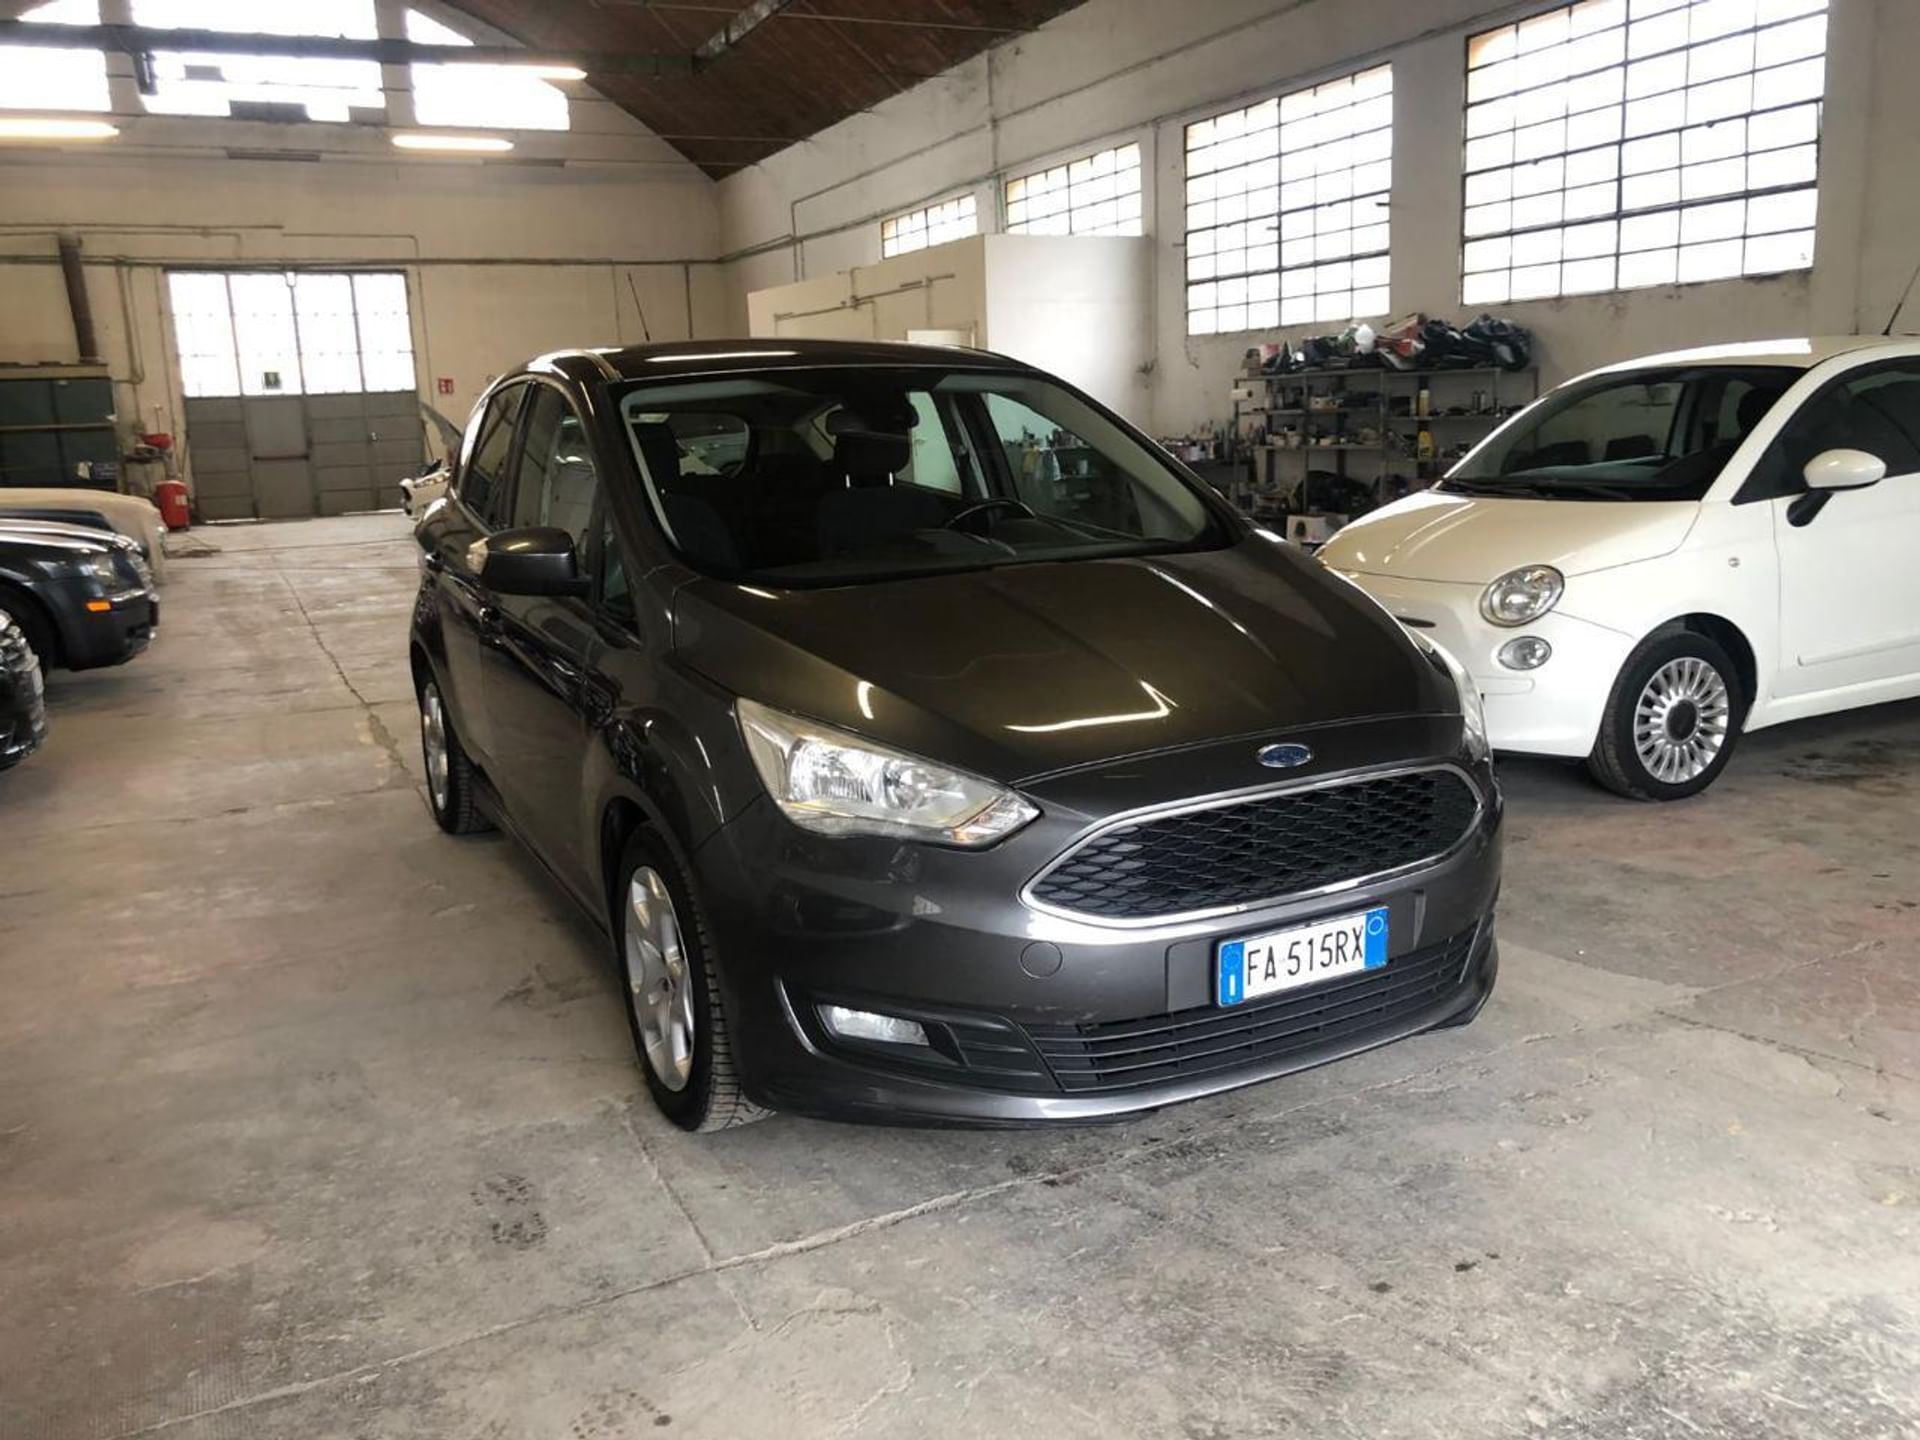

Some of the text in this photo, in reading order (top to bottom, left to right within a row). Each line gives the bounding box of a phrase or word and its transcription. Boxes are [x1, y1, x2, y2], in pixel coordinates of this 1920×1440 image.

[1229, 925, 1364, 997] I FA 515RX
